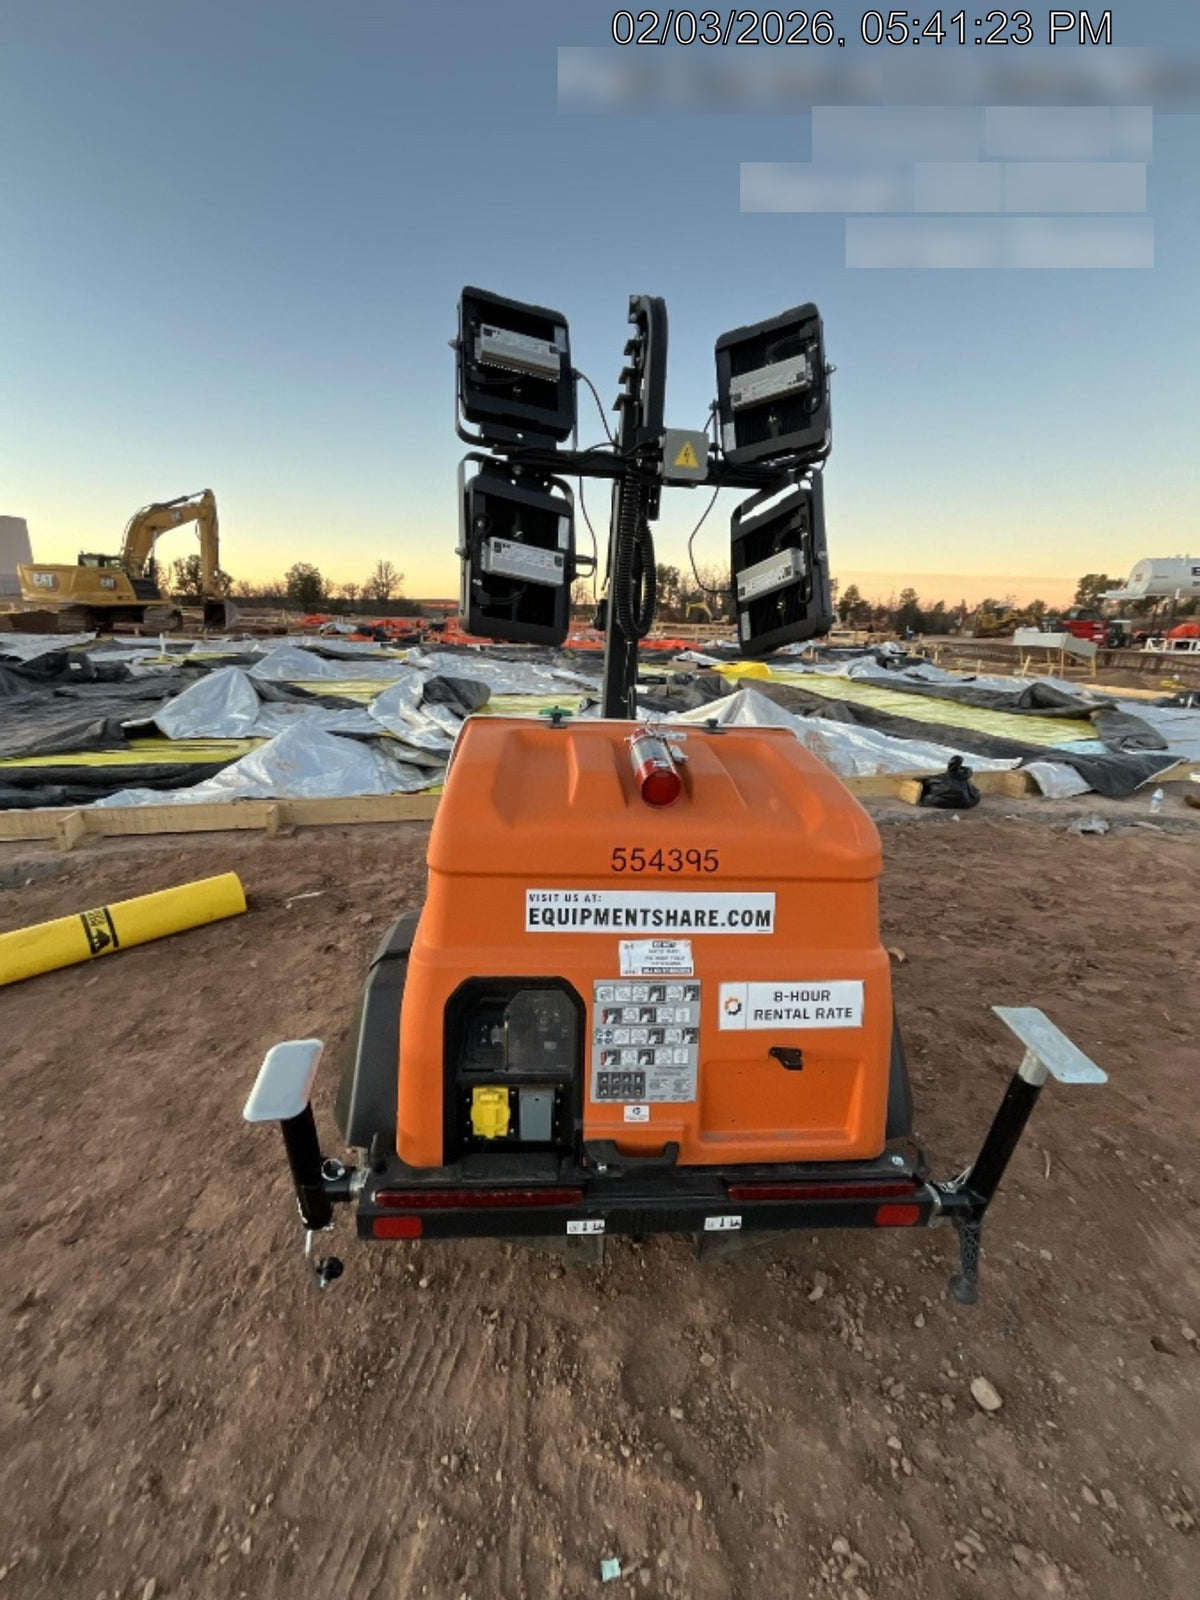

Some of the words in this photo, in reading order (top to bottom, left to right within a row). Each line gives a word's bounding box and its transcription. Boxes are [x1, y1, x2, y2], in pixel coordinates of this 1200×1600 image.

[611, 847, 719, 873] 554395
[529, 893, 559, 902] VISIT
[564, 893, 579, 902] US
[584, 893, 602, 903] AT:
[529, 908, 771, 927] EQUIPMENTSHARE.COM
[773, 990, 831, 1002] 8-HOUR
[754, 1008, 810, 1021] RENTAL
[815, 1007, 853, 1019] RATE
